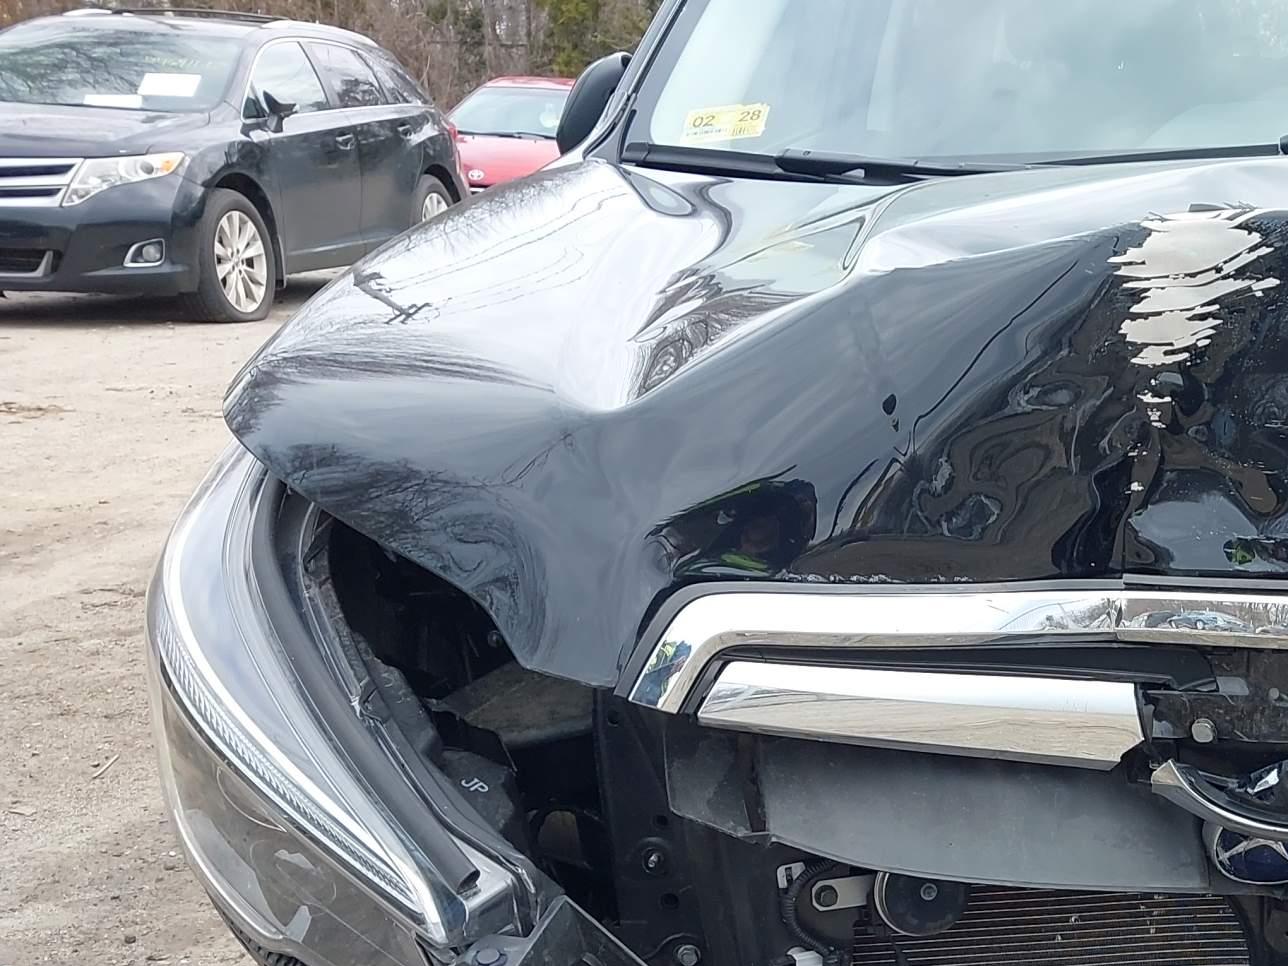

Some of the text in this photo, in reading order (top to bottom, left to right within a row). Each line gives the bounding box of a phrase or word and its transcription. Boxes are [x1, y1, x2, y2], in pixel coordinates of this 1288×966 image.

[692, 109, 762, 128] 02 28
[461, 777, 489, 793] JP
